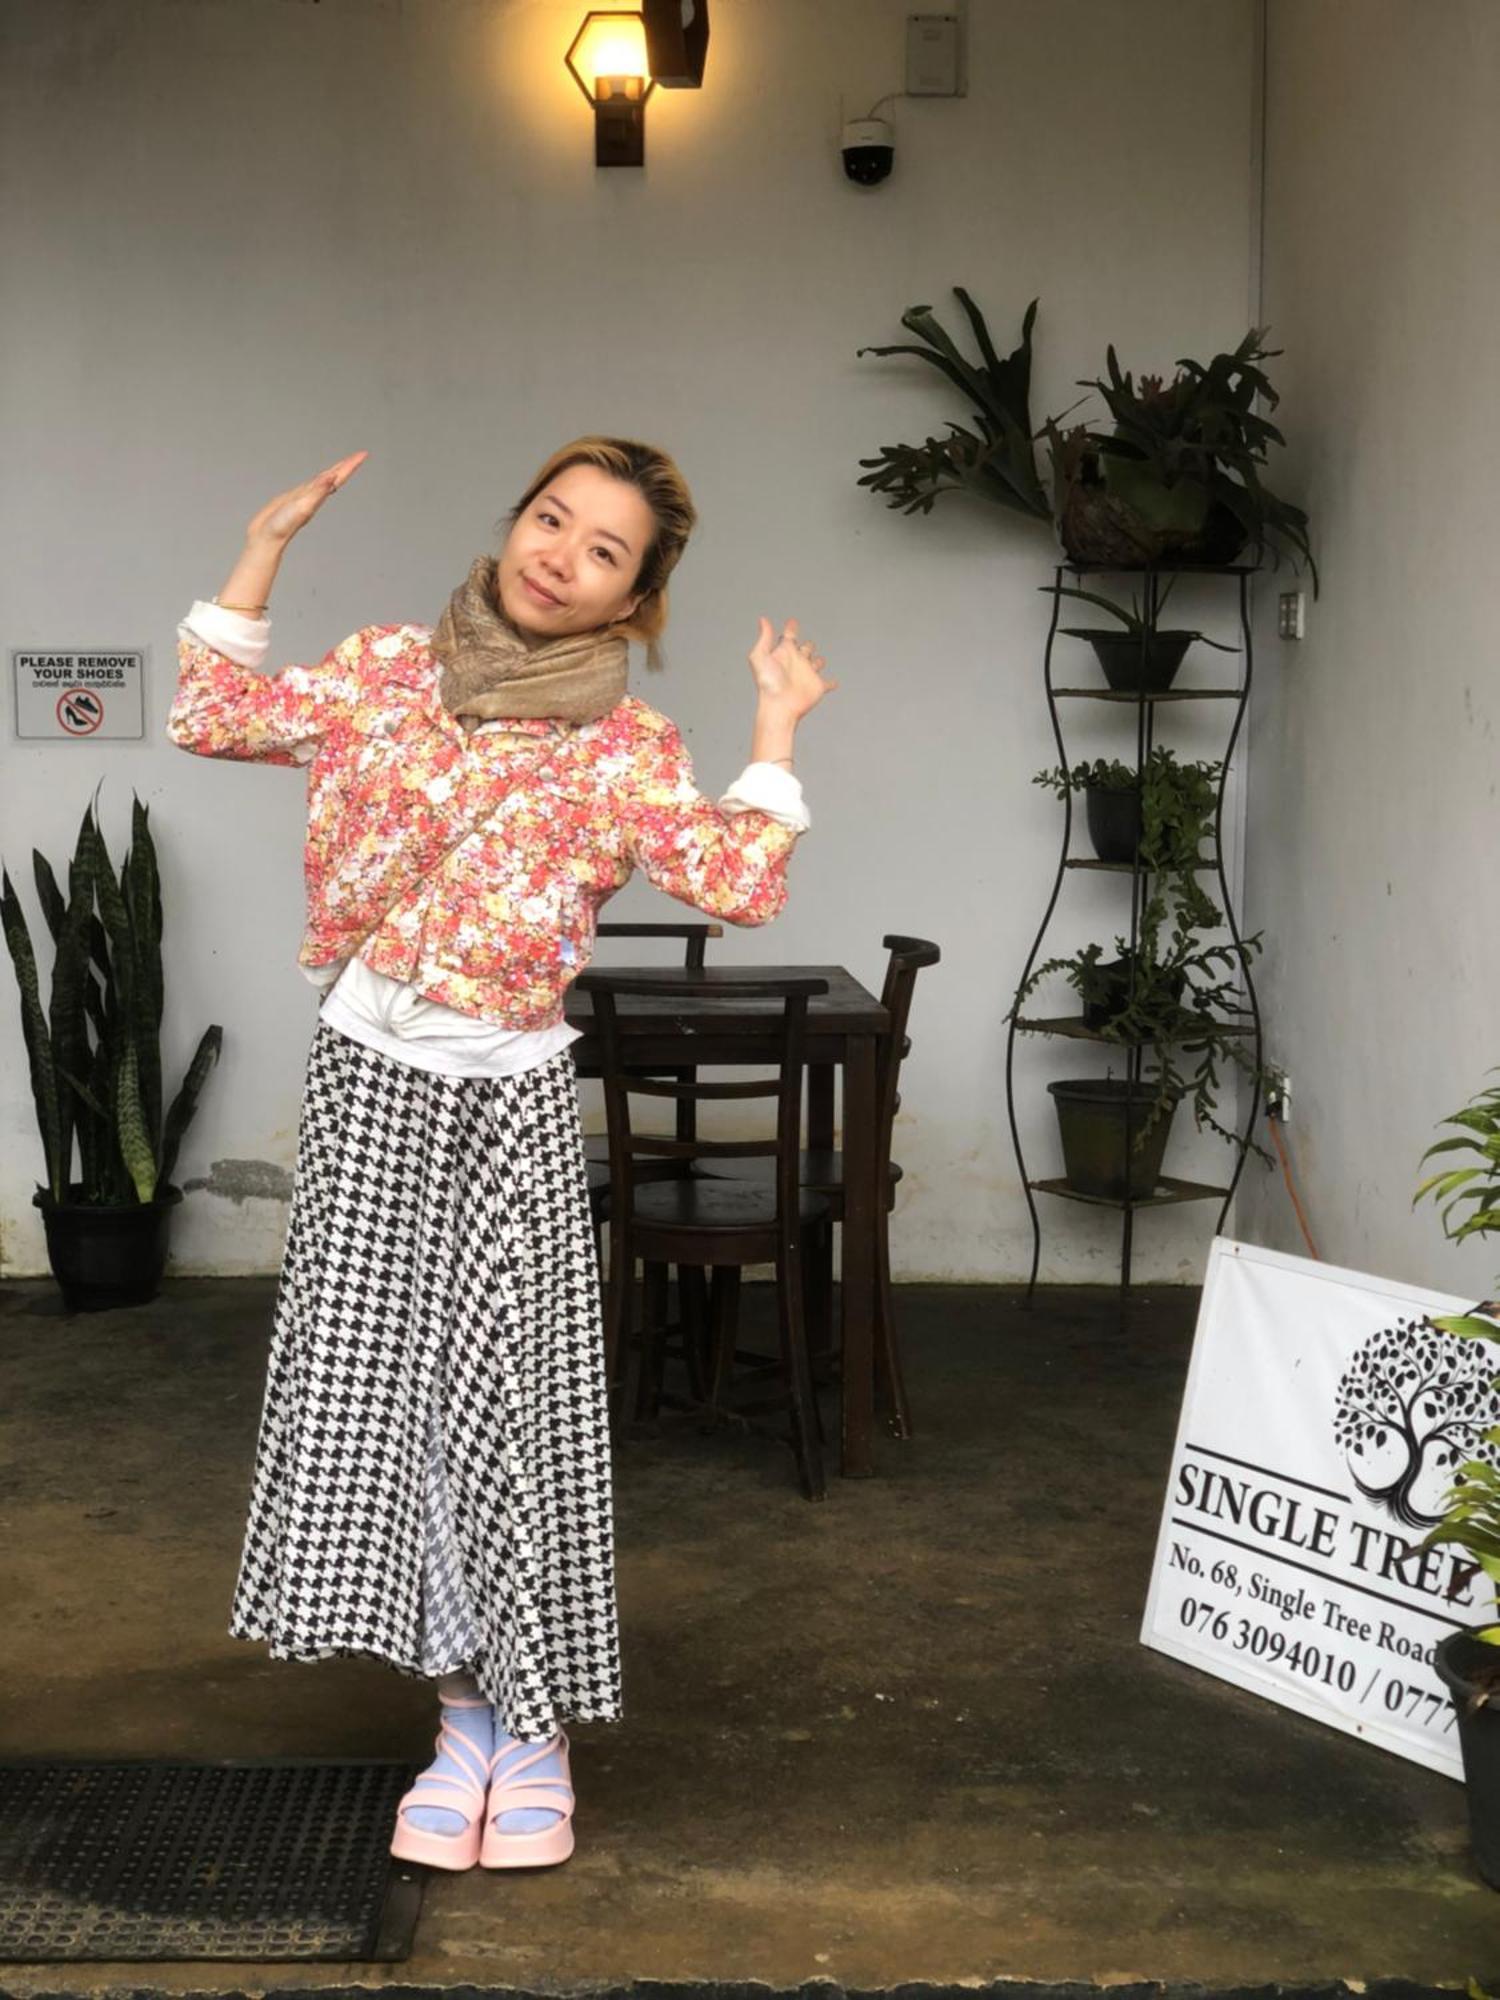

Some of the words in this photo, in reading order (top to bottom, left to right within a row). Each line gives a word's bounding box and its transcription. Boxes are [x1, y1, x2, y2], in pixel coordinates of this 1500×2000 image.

[20, 657, 74, 668] PLEASE
[78, 657, 136, 668] REMOVE
[34, 669, 73, 679] YOUR
[77, 669, 124, 679] SHOES
[1175, 1463, 1340, 1559] SINGLE
[1169, 1541, 1205, 1579] No.
[1211, 1559, 1243, 1598] 68,
[1248, 1572, 1316, 1622] Single
[1322, 1600, 1372, 1642] Tree
[1179, 1597, 1232, 1641] 076
[1232, 1619, 1357, 1693] 3094010
[1360, 1668, 1382, 1704] /
